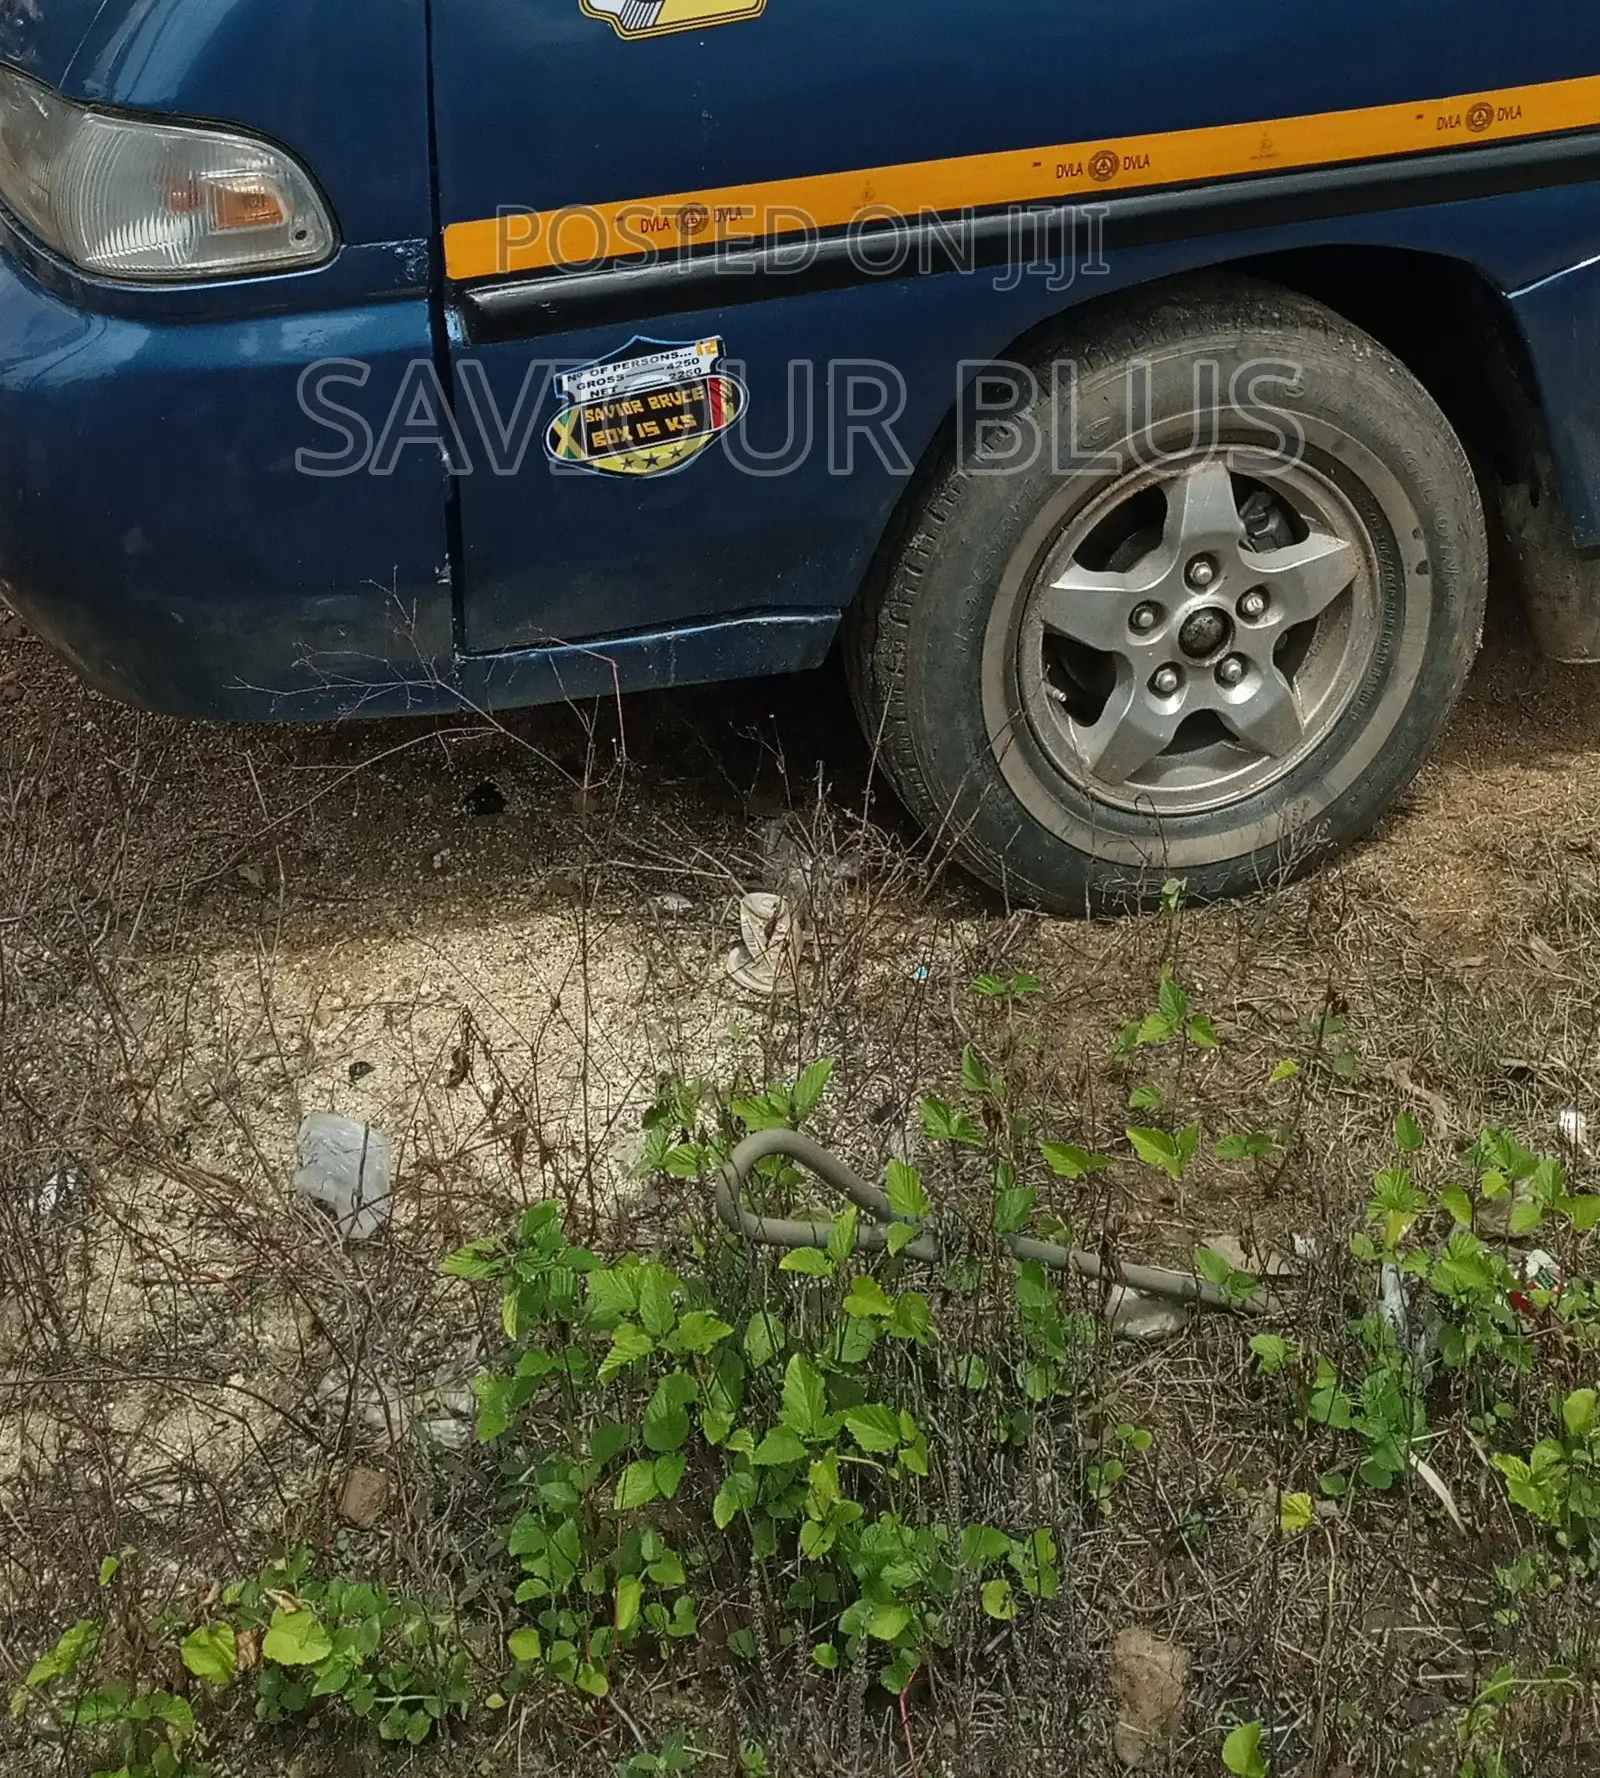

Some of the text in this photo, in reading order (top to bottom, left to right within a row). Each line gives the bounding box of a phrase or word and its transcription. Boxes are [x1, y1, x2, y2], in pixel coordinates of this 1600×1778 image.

[1437, 106, 1522, 131] DVLA DVLA
[1056, 162, 1083, 179] DVLA
[1123, 154, 1150, 171] DVLA
[640, 216, 670, 234] DVLA
[713, 207, 743, 223] DVLA
[576, 358, 700, 391] GROSS 4250
[590, 368, 608, 377] OF
[590, 367, 702, 399] NET 2250
[585, 385, 705, 423] SAVIOR BRUCE
[591, 423, 634, 448] BOX
